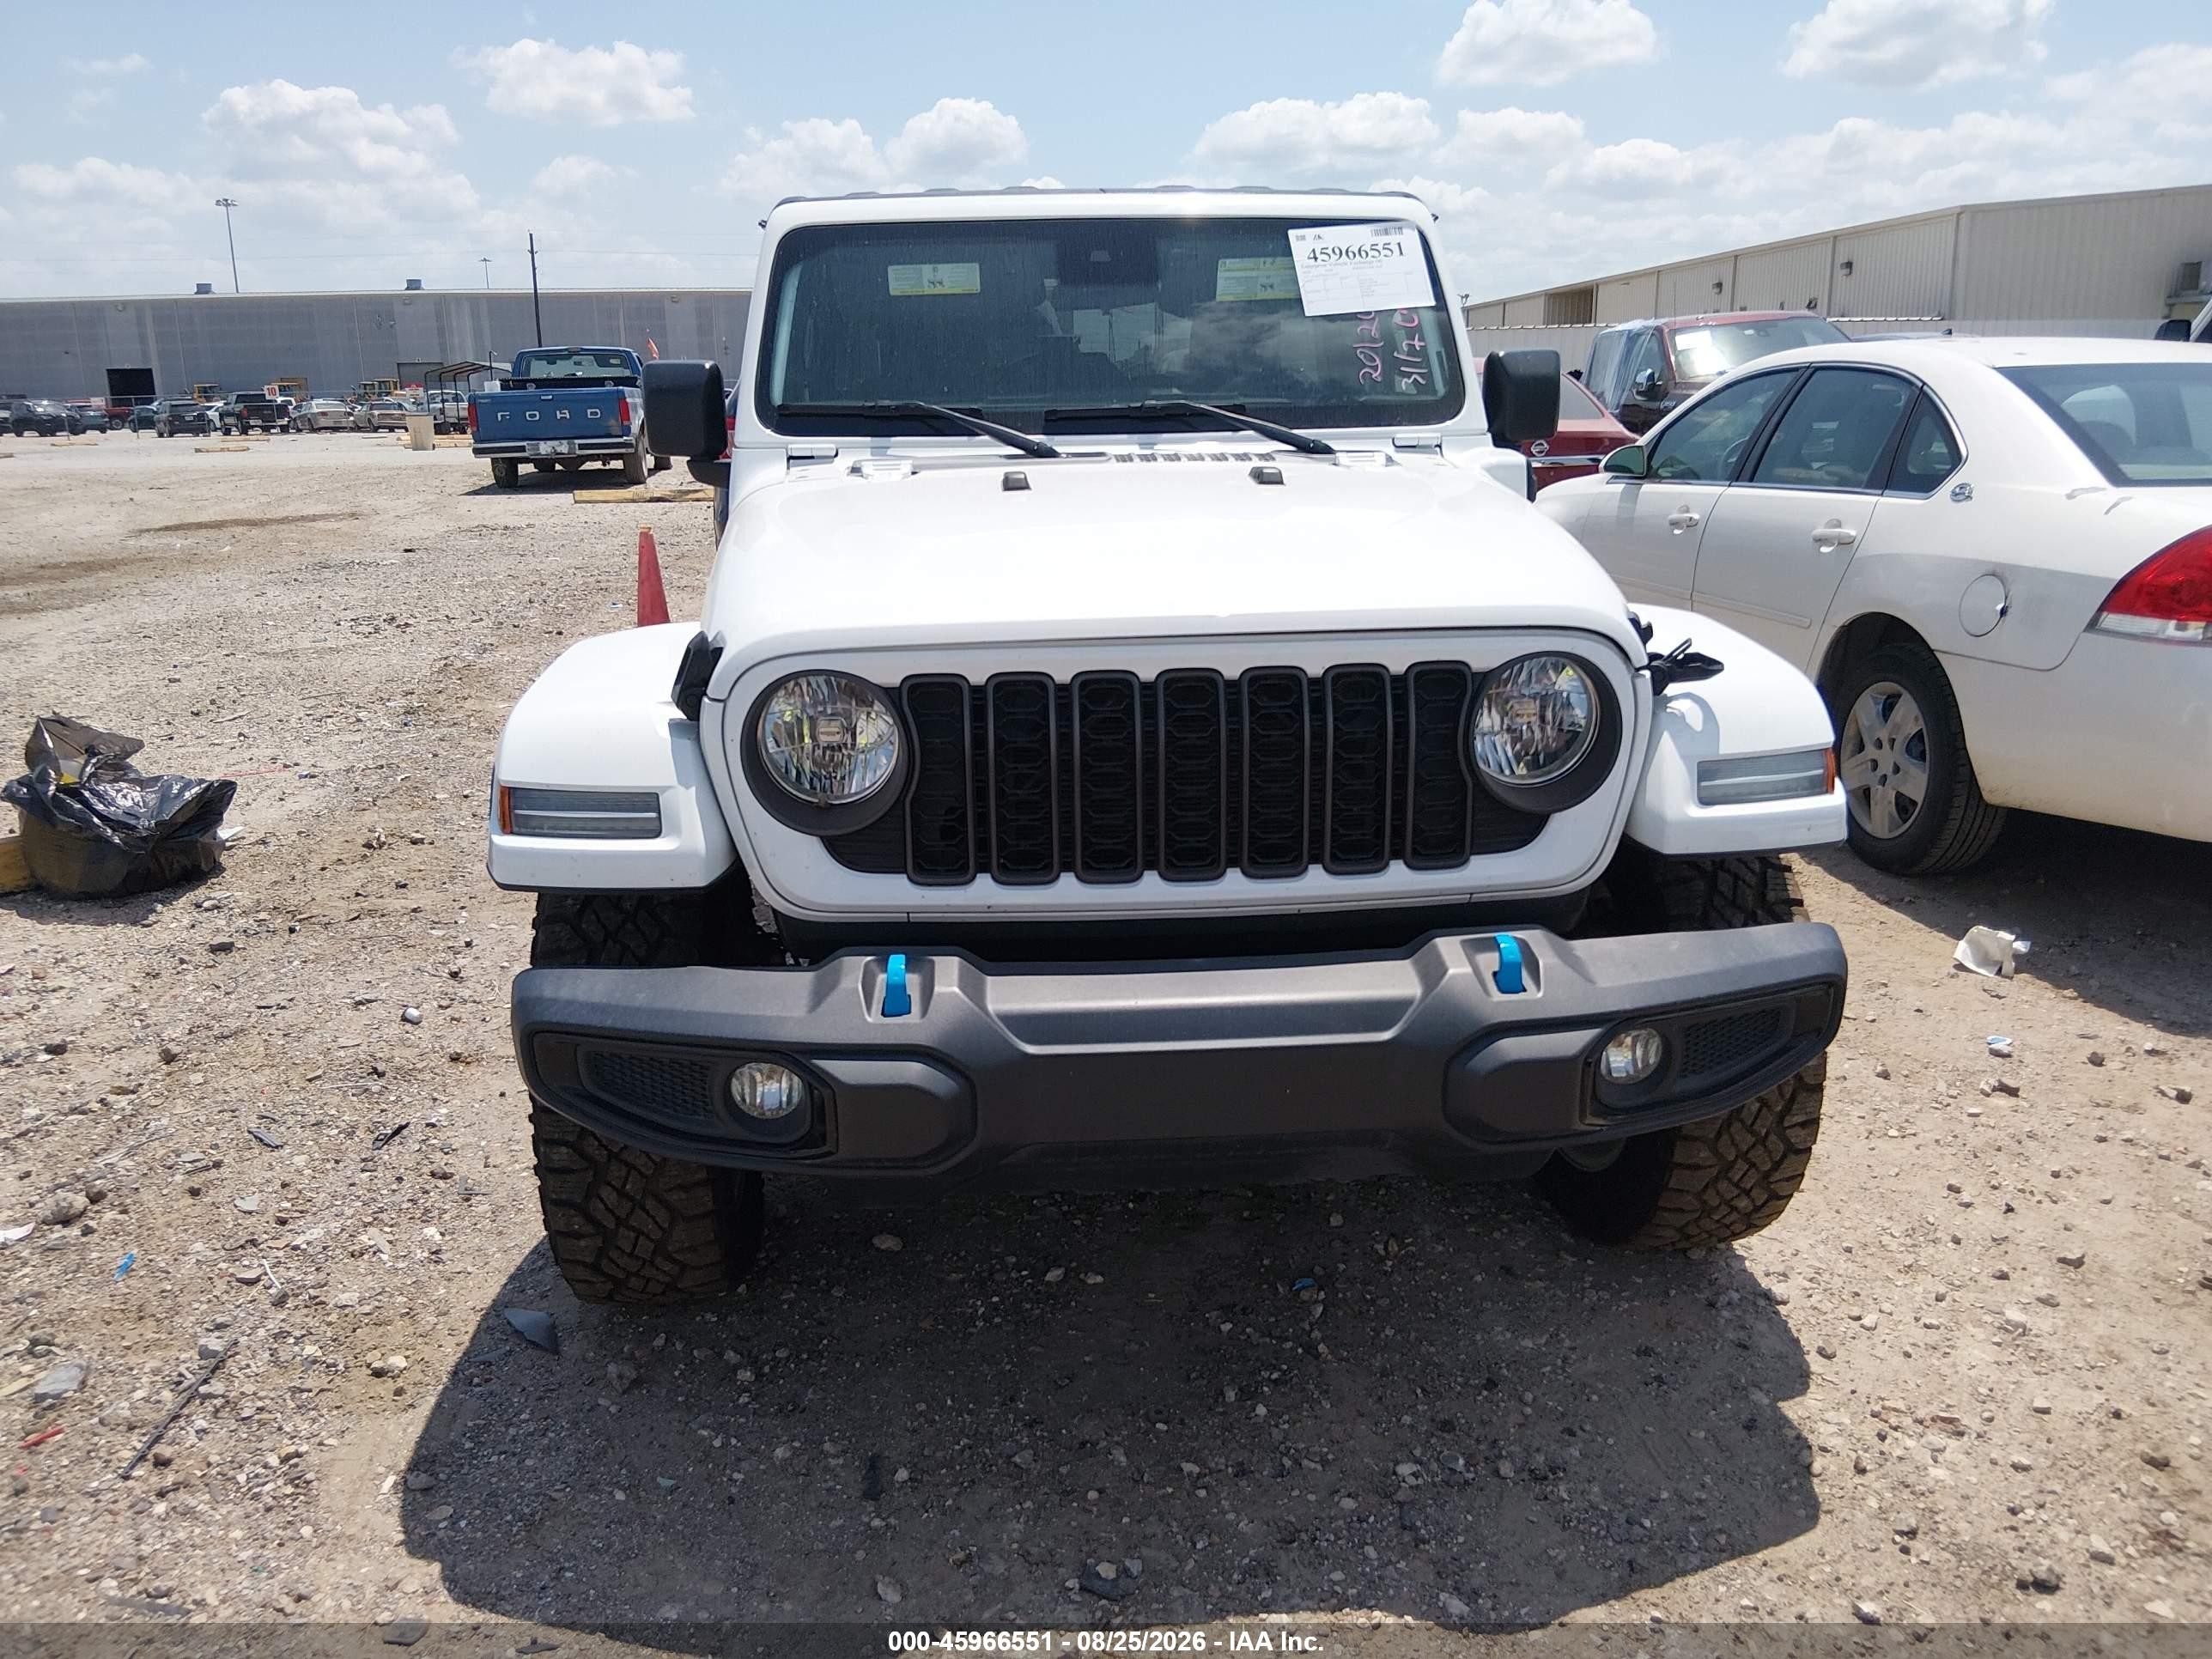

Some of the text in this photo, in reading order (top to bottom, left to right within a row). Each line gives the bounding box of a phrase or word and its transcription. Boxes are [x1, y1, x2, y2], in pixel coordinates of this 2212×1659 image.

[1307, 241, 1404, 263] 45966551
[266, 386, 276, 397] 10
[497, 409, 602, 422] FORD
